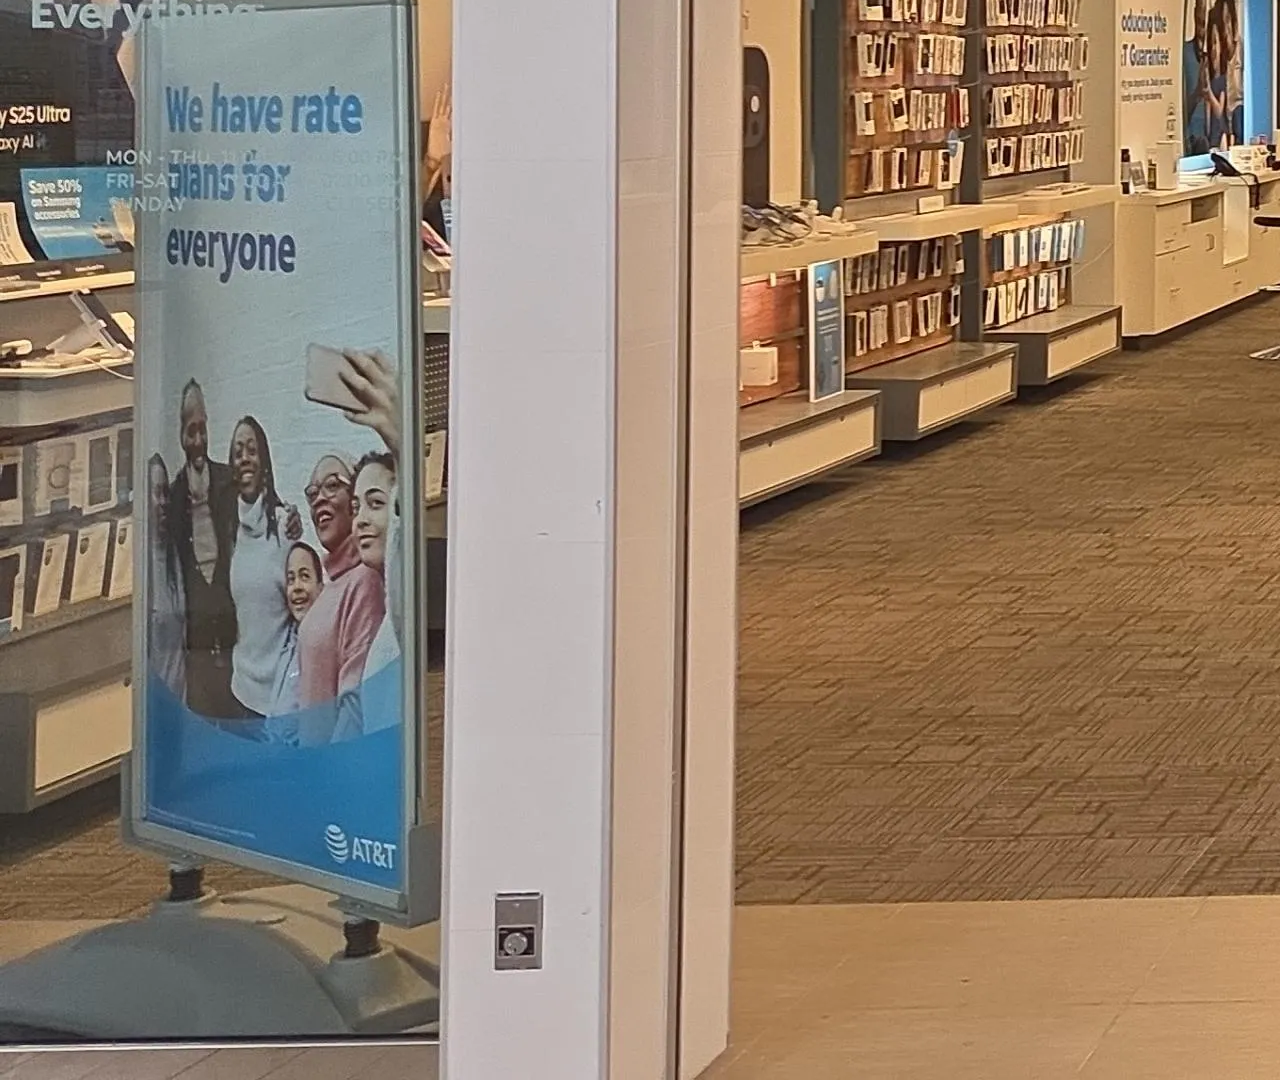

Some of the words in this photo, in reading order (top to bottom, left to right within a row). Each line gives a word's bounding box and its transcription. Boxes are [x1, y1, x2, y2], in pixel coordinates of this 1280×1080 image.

[9, 105, 35, 124] S25
[36, 105, 71, 123] Ultra
[165, 86, 204, 133] We
[210, 82, 283, 133] have
[291, 86, 363, 134] rate
[106, 150, 151, 165] MON
[28, 180, 56, 194] Save
[57, 179, 82, 193] 50%
[106, 173, 179, 188] FRI-SAT
[166, 227, 296, 284] everyone
[351, 836, 397, 869] AT&T
